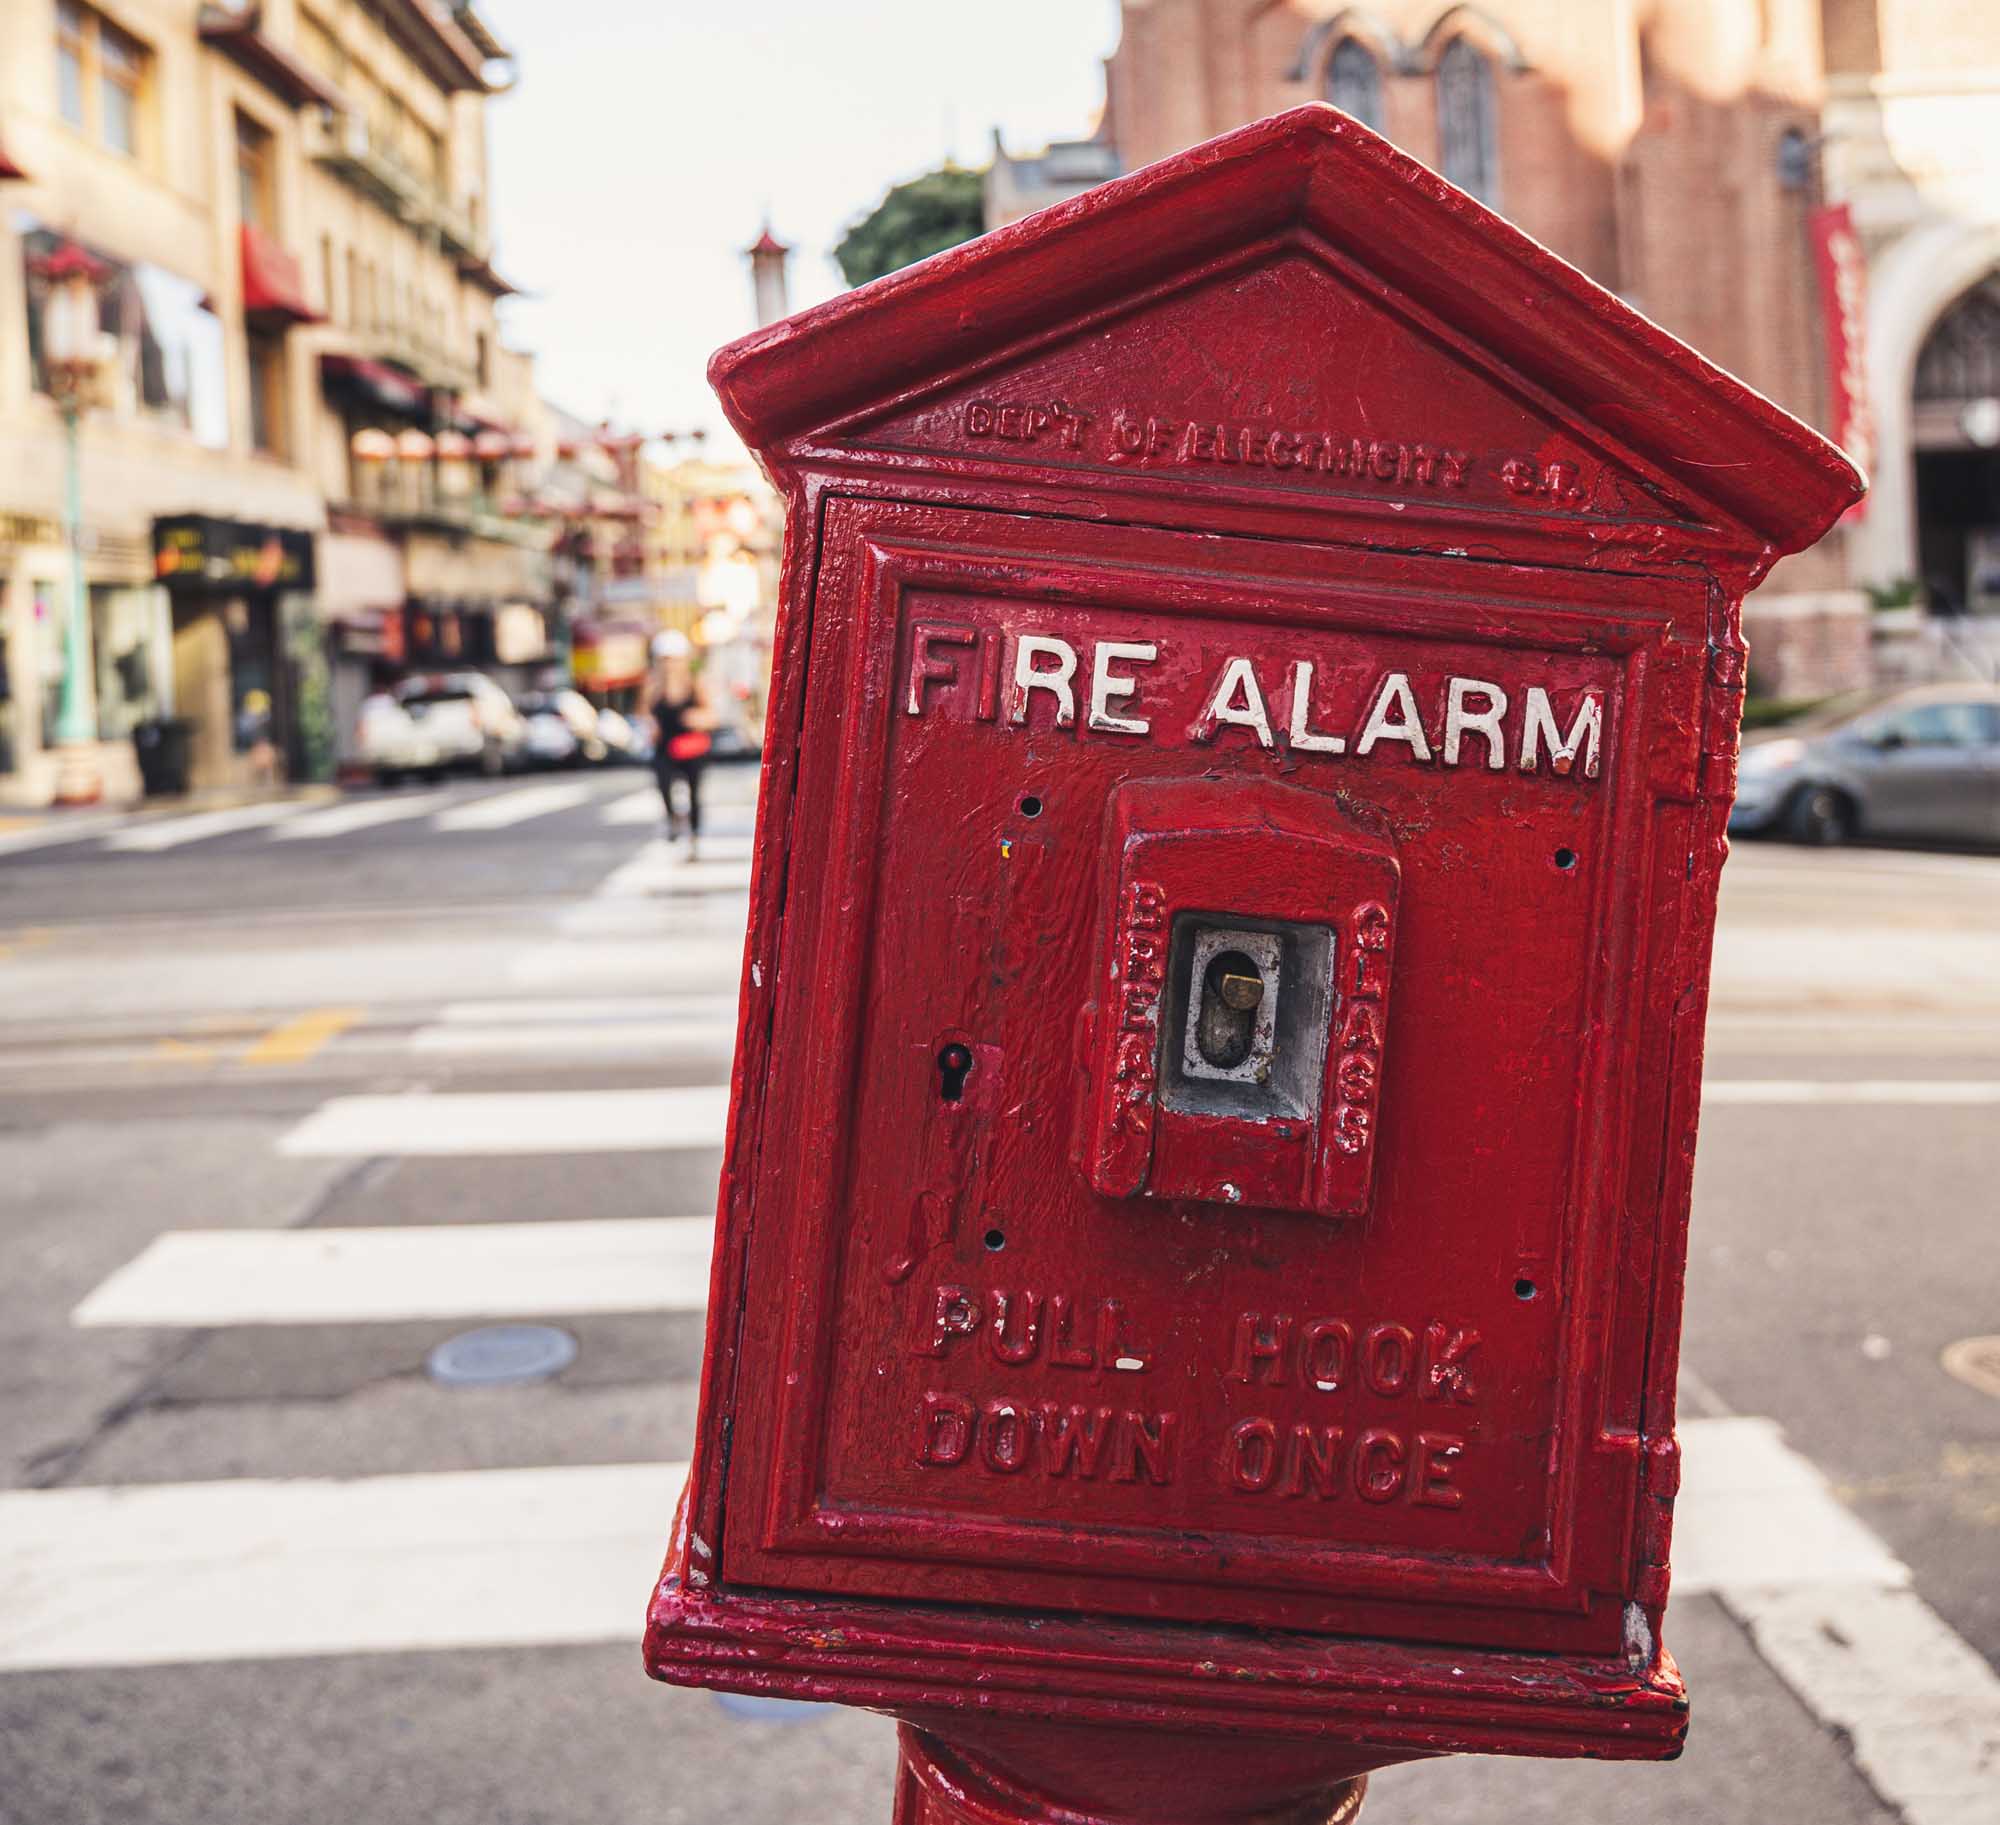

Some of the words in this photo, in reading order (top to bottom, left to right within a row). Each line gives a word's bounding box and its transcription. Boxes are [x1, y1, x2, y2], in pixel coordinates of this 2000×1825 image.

[1114, 411, 1178, 458] OF
[906, 624, 1158, 735] FIRE
[1194, 658, 1603, 779] ALARM
[1334, 901, 1390, 1153] GLASS
[911, 1285, 1152, 1373] PULL
[1228, 1311, 1482, 1404] HOOK
[915, 1390, 1179, 1486] DOWN
[1229, 1417, 1465, 1509] ONCE
